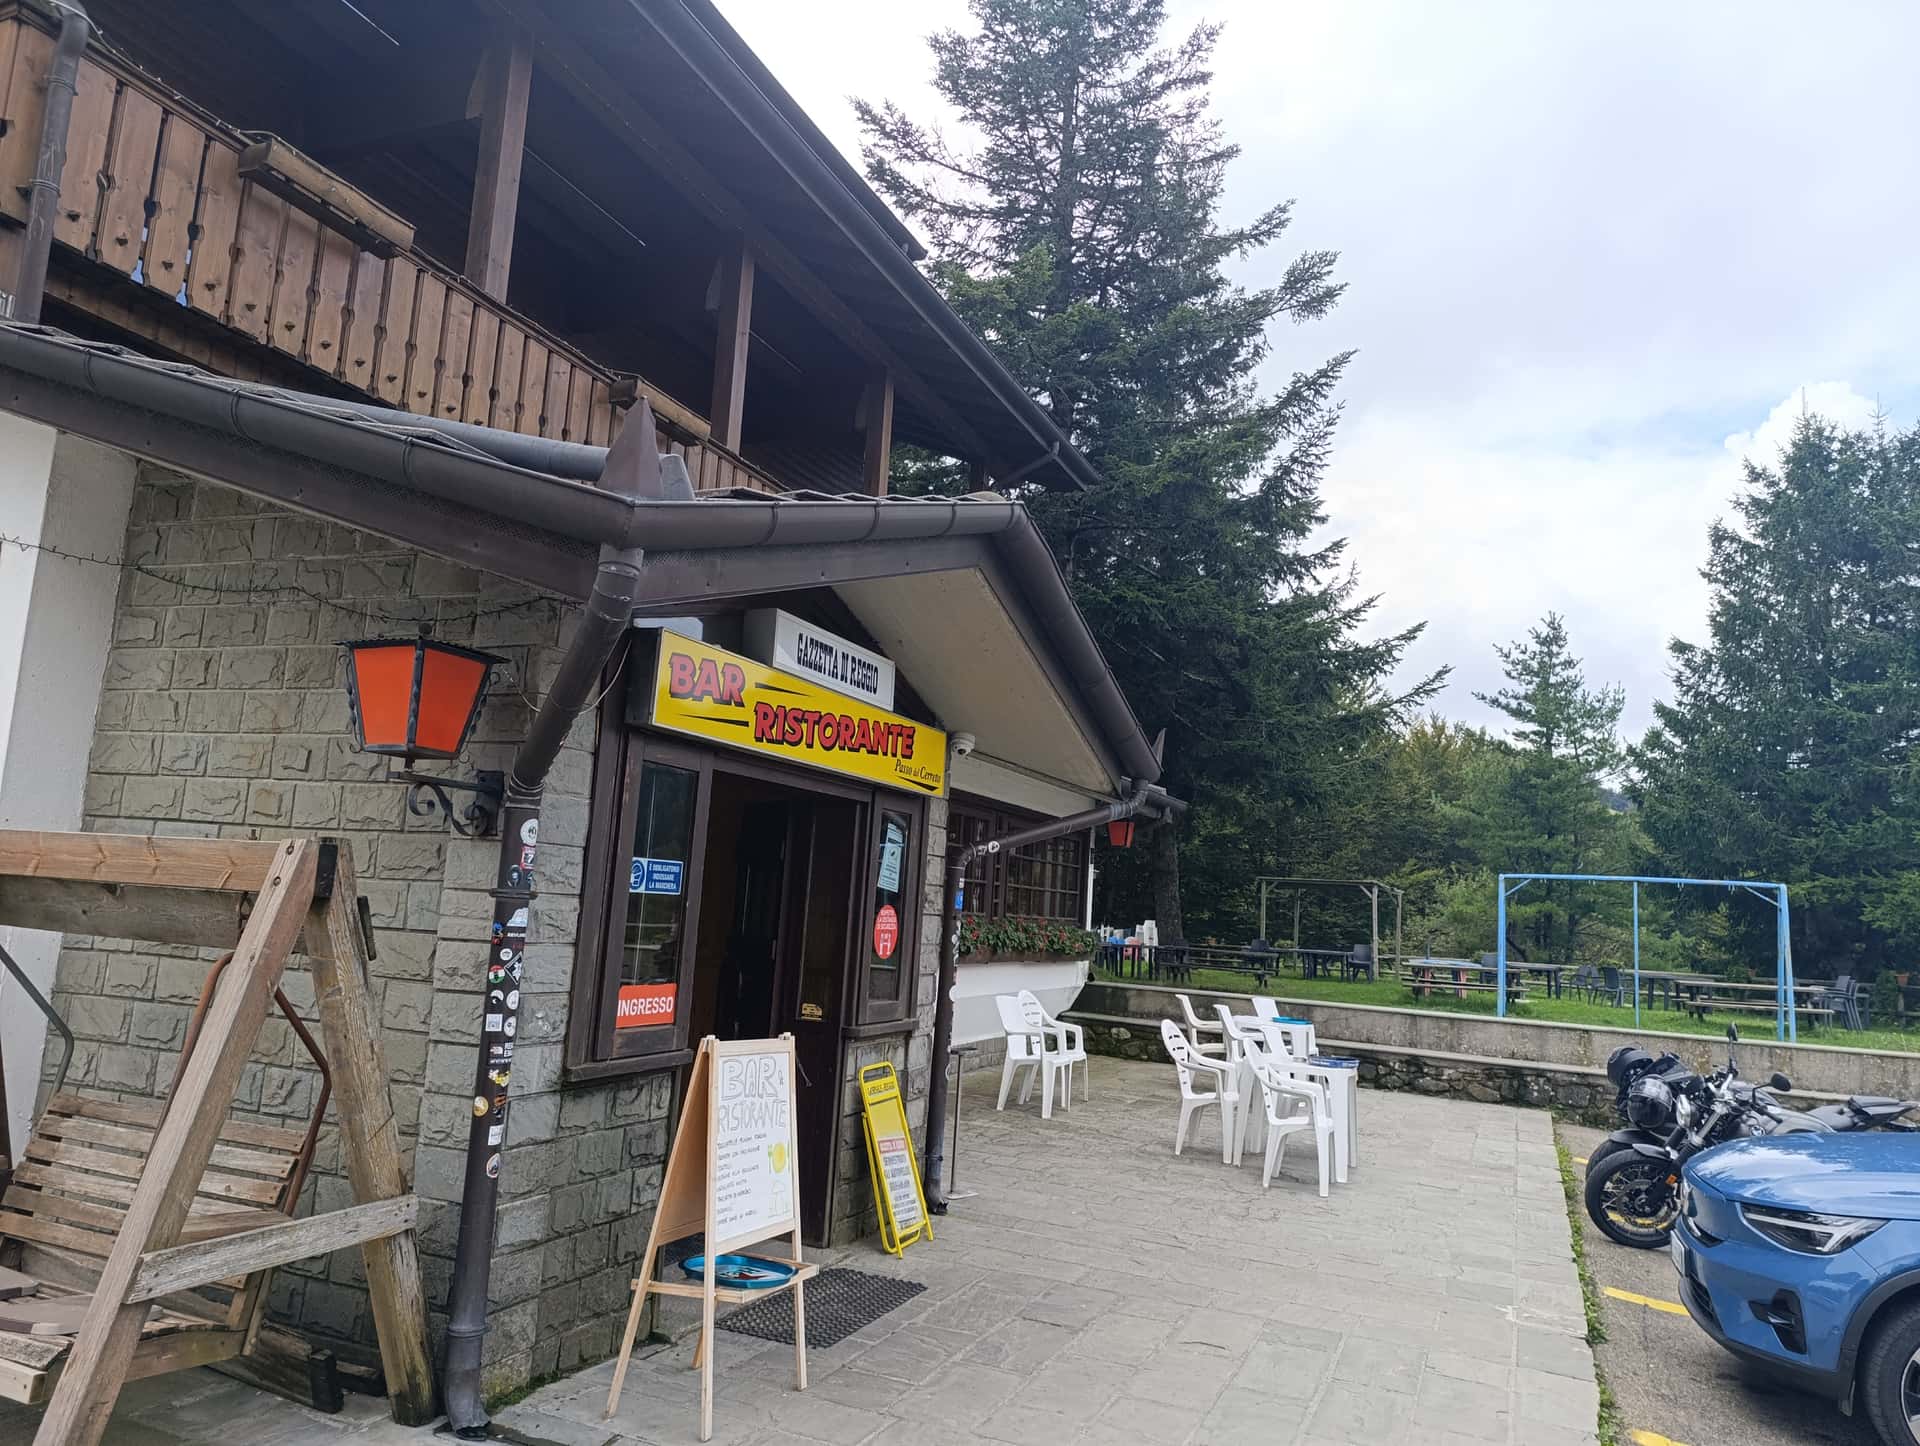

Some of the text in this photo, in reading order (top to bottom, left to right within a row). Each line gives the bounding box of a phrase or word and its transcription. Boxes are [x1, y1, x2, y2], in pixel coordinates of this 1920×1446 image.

[669, 652, 746, 708] BAR
[797, 632, 879, 695] GAZZETTA DI REGGIO
[754, 701, 916, 760] RISTORANTE
[617, 996, 673, 1017] INGRESSO
[721, 1056, 778, 1101] BAR
[717, 1099, 788, 1133] RISTORANTE
